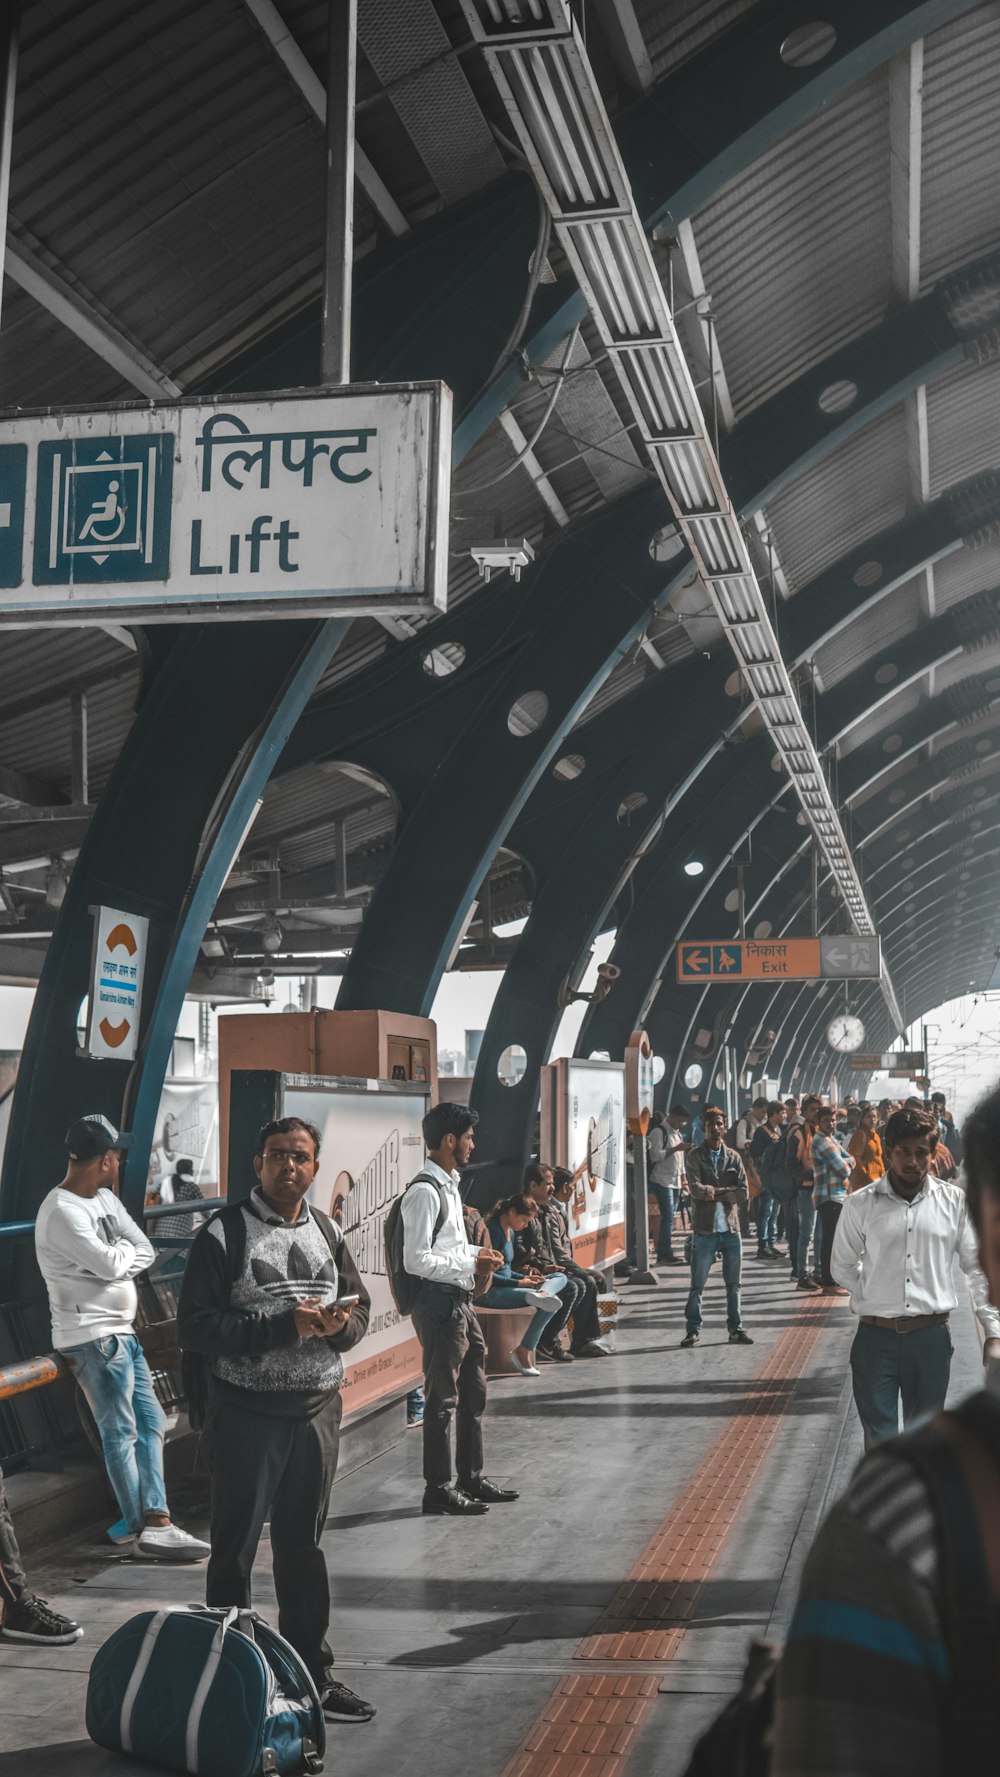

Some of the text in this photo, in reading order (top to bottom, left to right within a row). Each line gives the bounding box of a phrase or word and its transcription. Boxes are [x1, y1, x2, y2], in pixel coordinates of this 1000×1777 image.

[196, 413, 377, 492] लिफ्ट
[190, 515, 300, 576] Lift
[746, 942, 787, 957] निकास
[763, 961, 788, 973] Exit
[361, 1129, 399, 1220] YOUR
